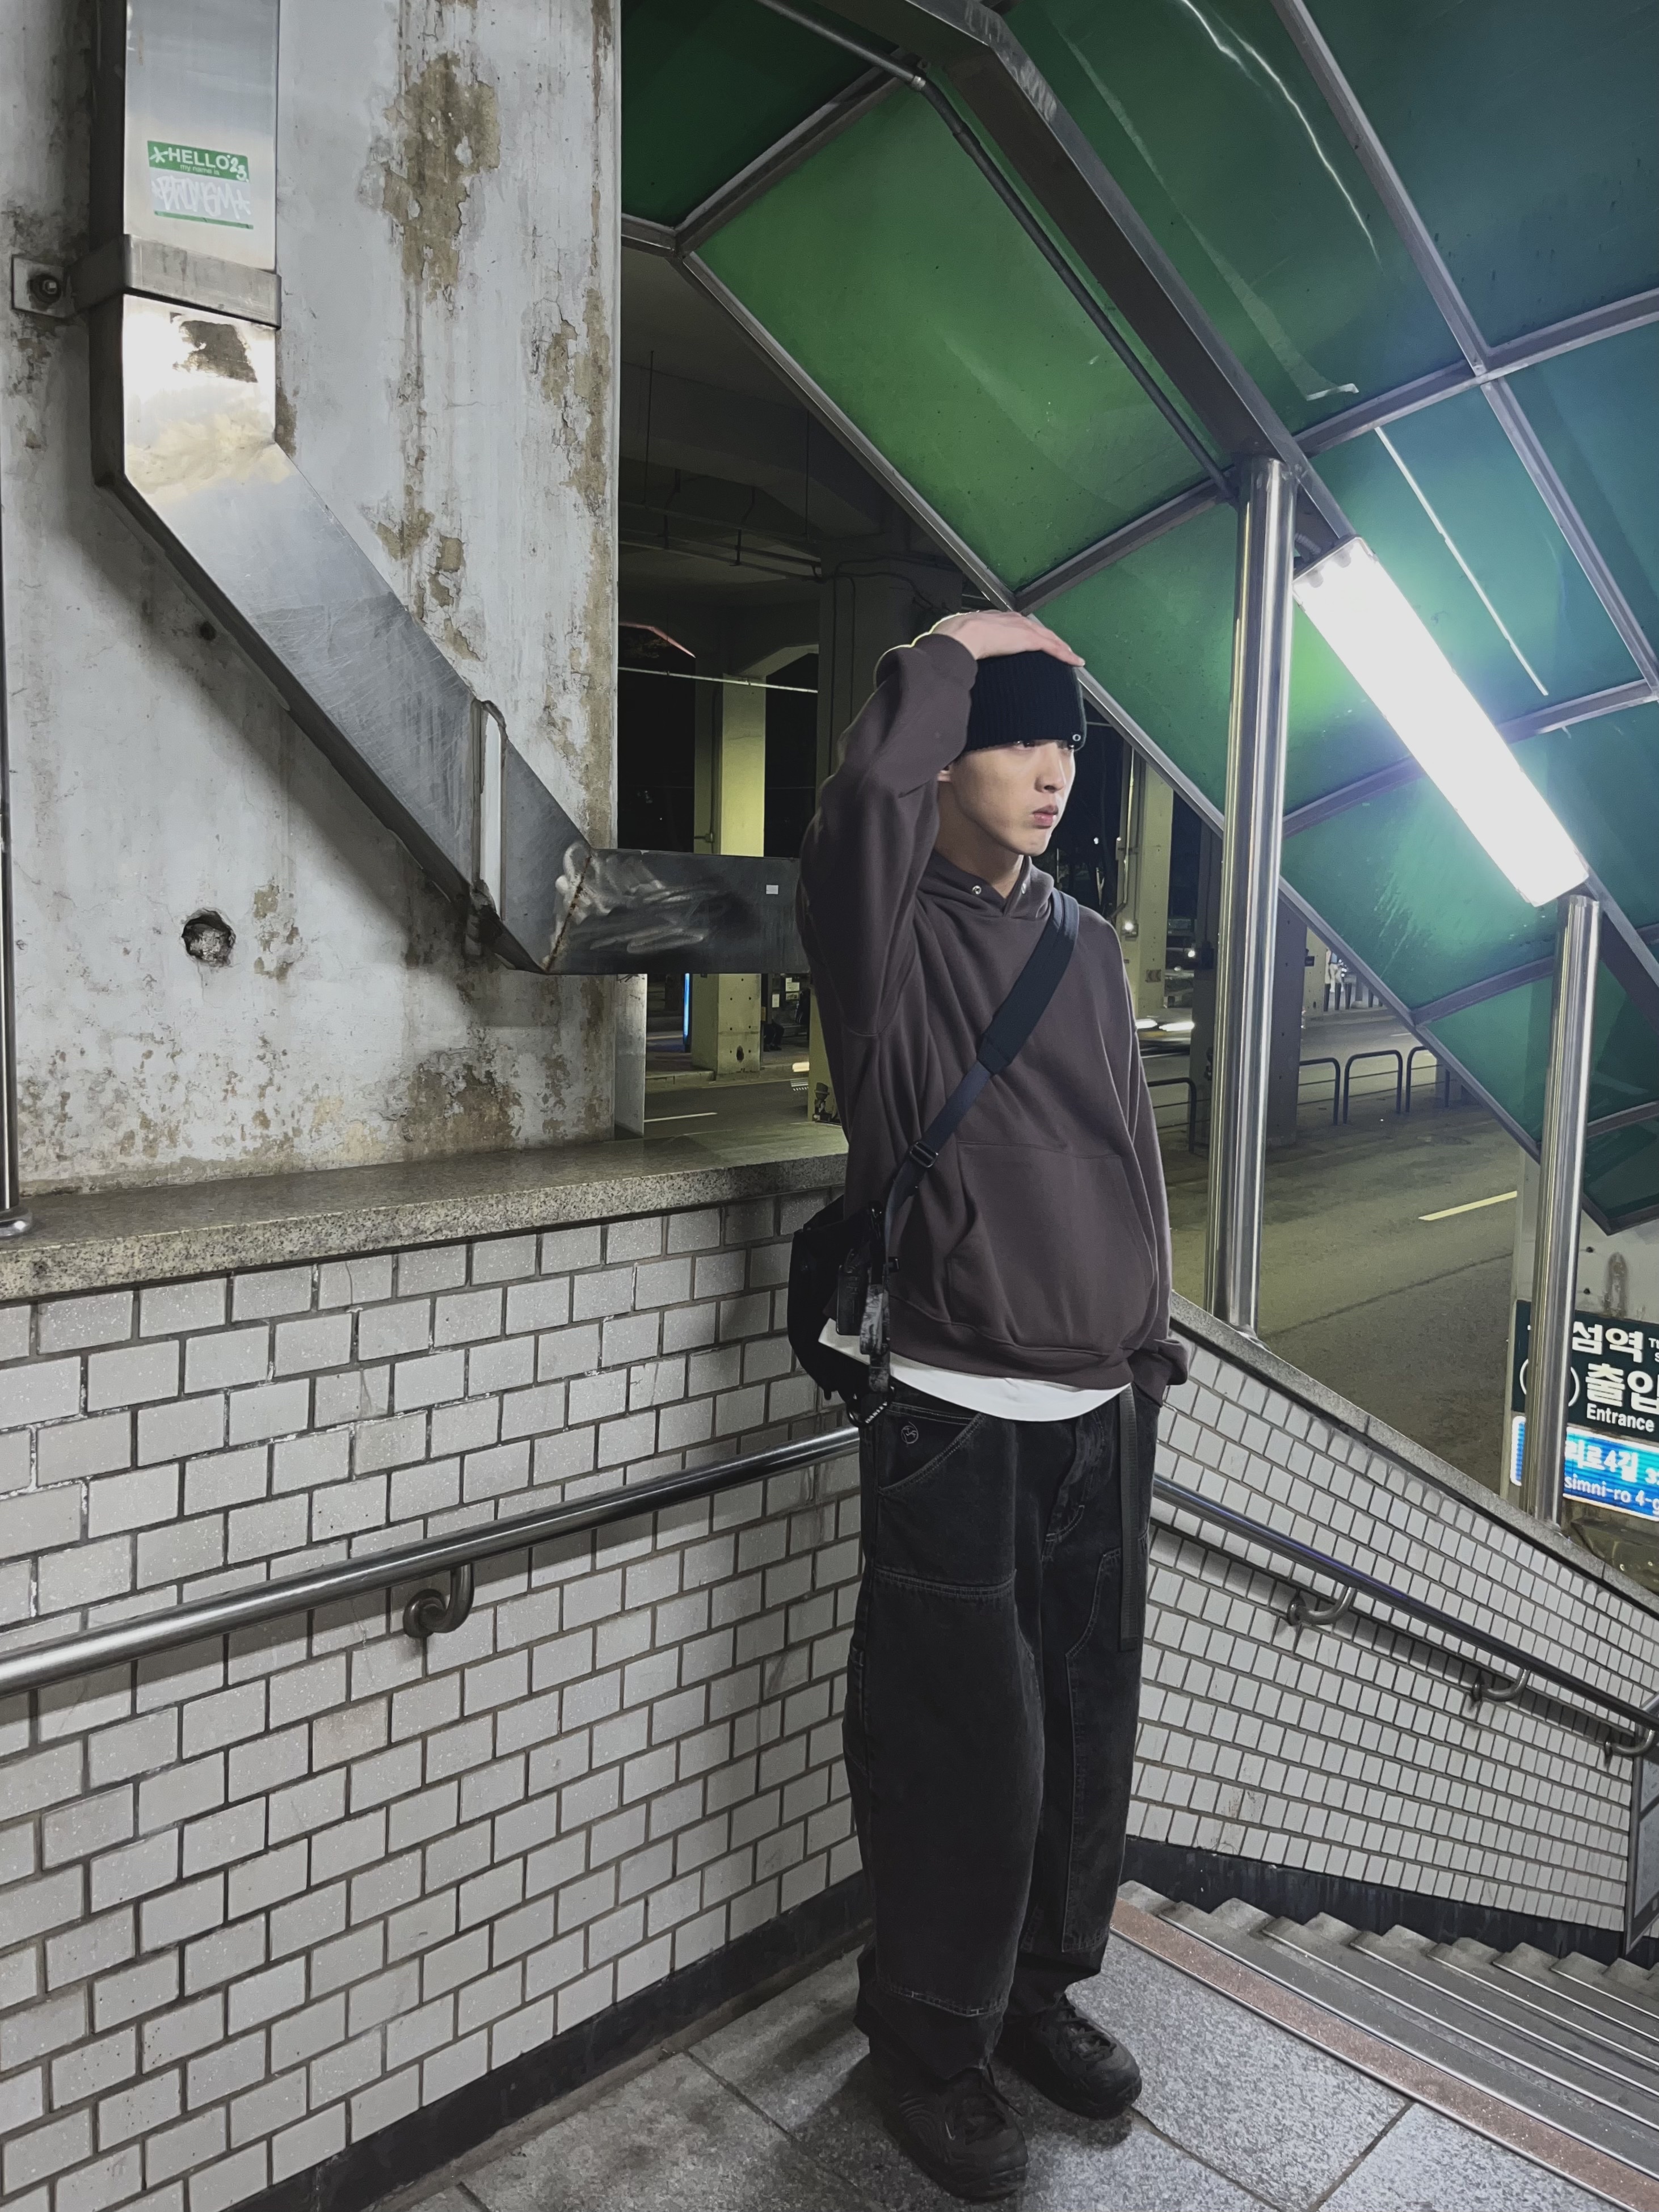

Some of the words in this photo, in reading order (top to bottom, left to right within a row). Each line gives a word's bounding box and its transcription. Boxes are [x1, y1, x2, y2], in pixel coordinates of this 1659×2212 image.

[168, 147, 229, 170] HELLO
[1572, 1321, 1643, 1363] 섬역
[1586, 1403, 1654, 1432] Entrance
[1565, 1439, 1638, 1482] 리로4길
[1564, 1473, 1631, 1503] simni-ro
[1635, 1490, 1659, 1515] 4-g
